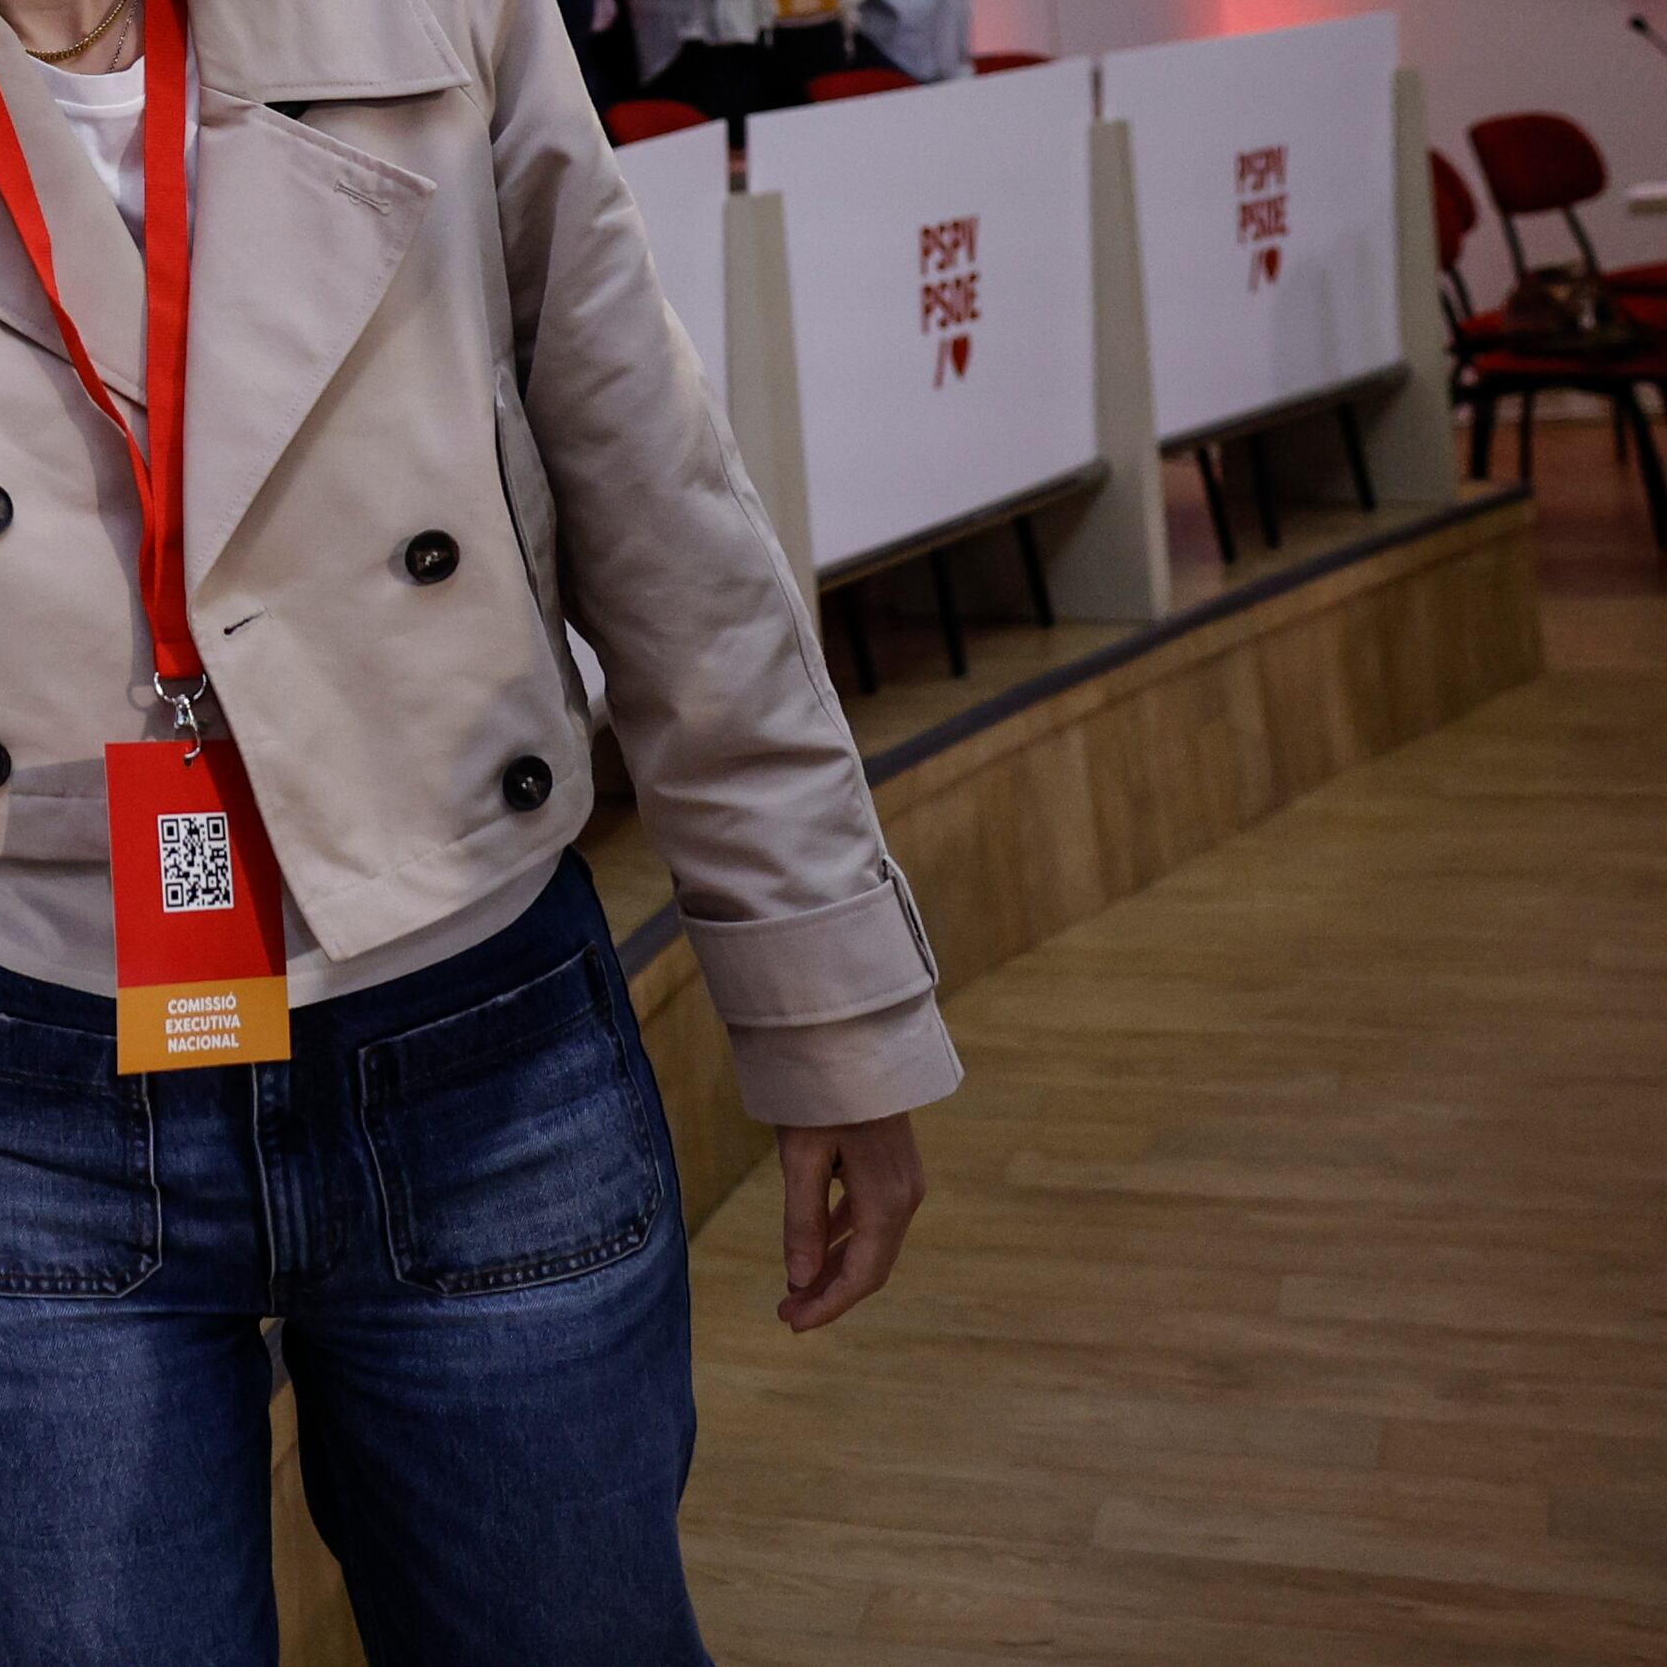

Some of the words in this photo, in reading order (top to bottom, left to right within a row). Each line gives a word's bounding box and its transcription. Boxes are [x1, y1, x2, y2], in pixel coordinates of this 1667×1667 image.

[921, 269, 981, 334] PSOE
[167, 991, 237, 1015] COMISSIÓ
[165, 1013, 241, 1035] EXECUTIVA
[168, 1033, 240, 1054] NACIONAL
